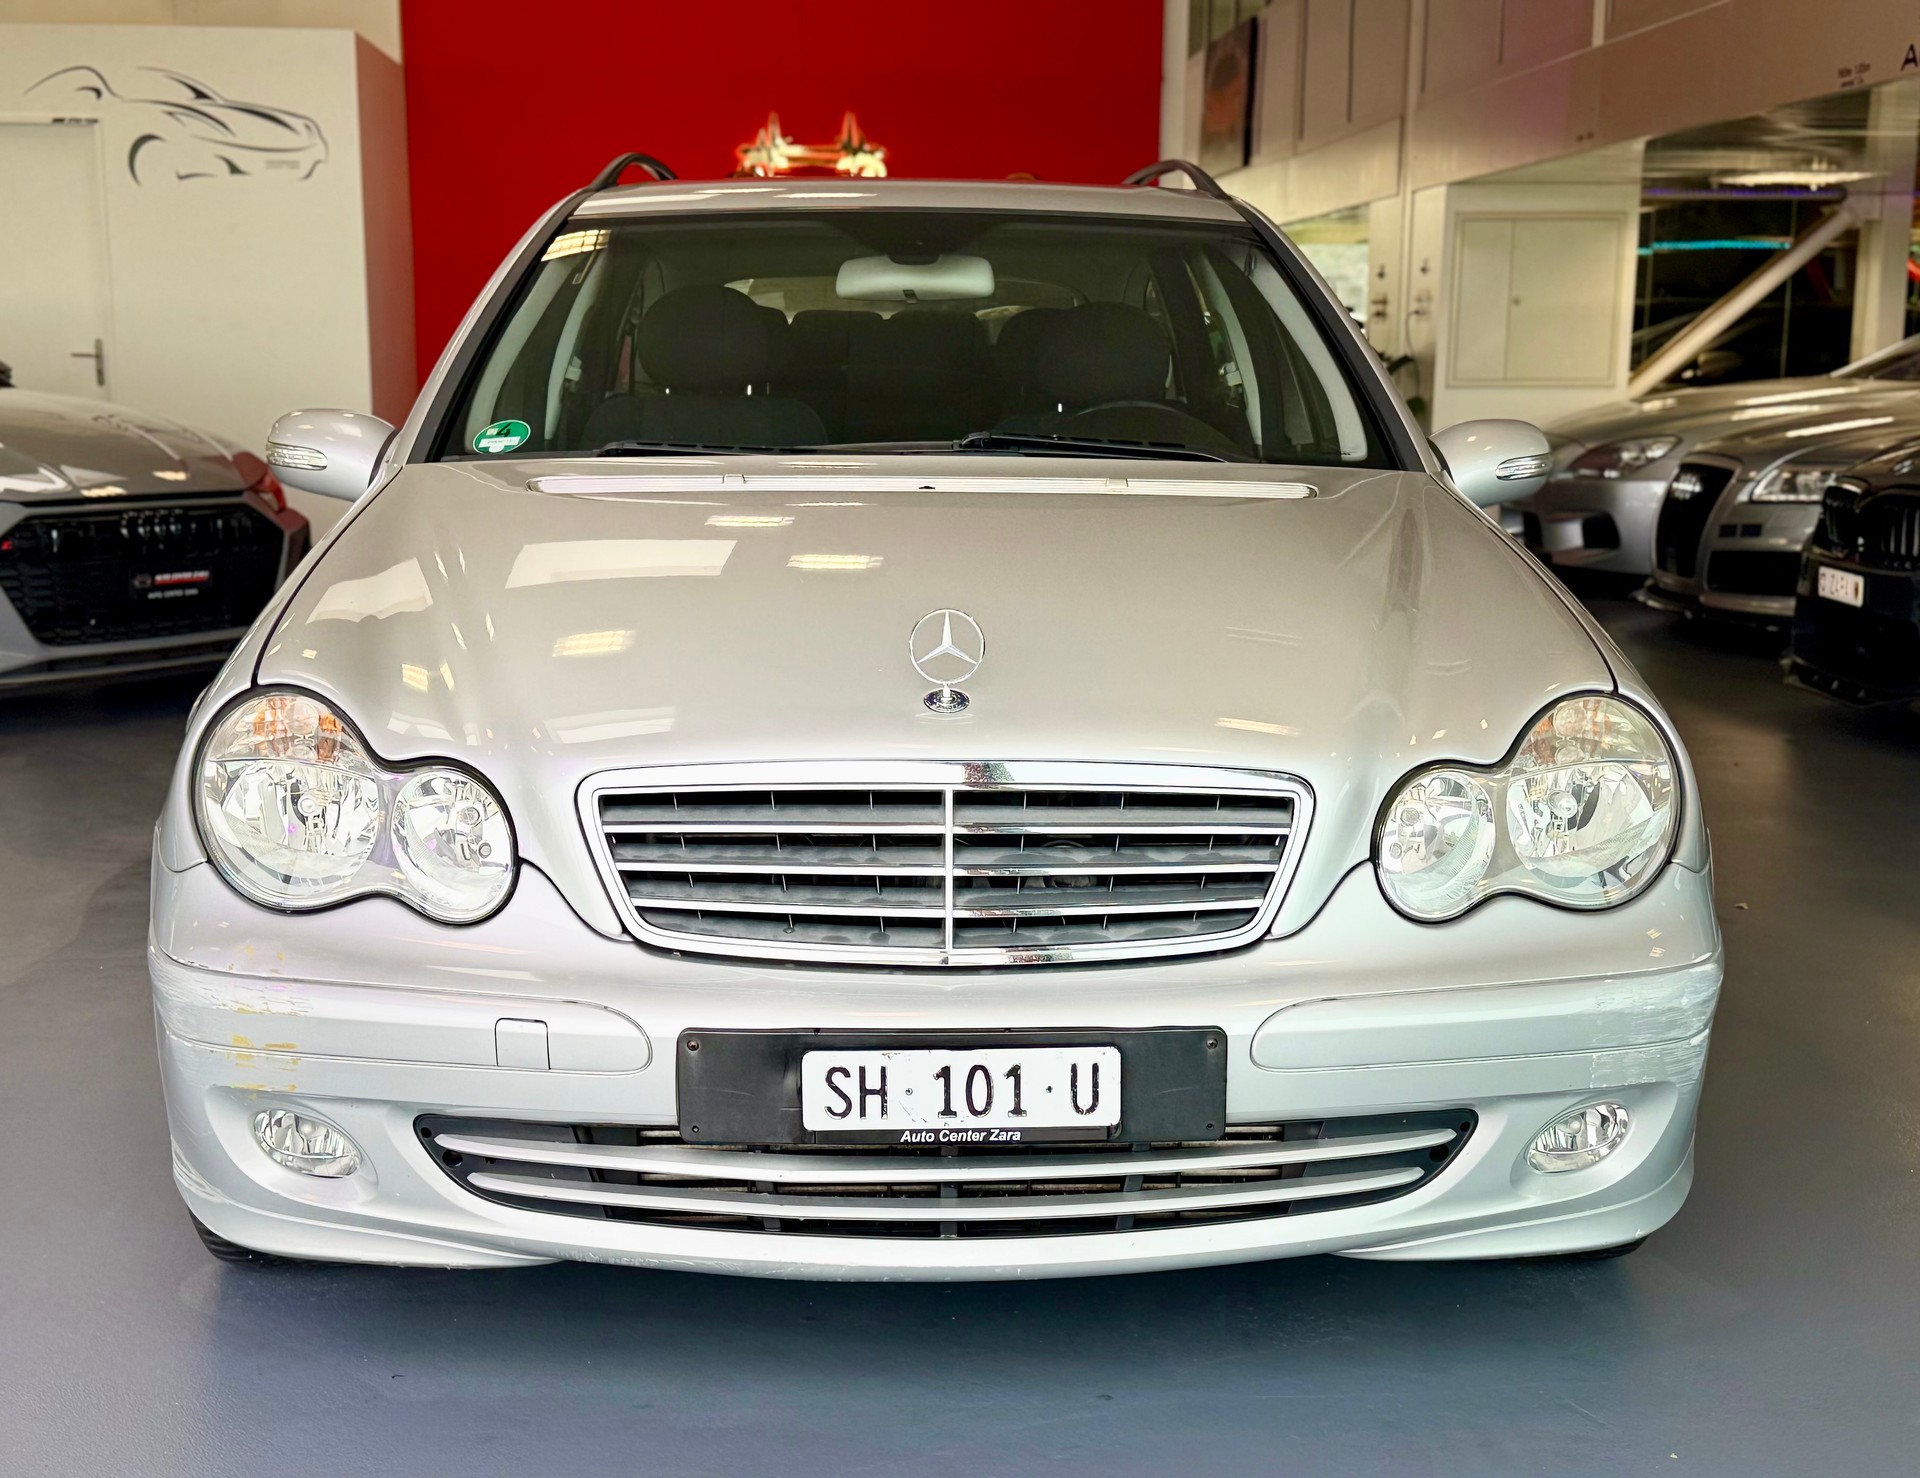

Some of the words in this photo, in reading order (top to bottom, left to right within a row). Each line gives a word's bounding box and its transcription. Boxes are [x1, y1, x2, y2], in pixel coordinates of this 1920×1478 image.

[1900, 42, 1920, 72] A
[496, 421, 513, 437] 4
[824, 1065, 889, 1120] SH
[932, 1062, 1028, 1119] 101
[1070, 1062, 1100, 1116] U
[900, 1129, 935, 1143] Auto
[939, 1129, 987, 1142] Center
[989, 1128, 1021, 1142] Zara
